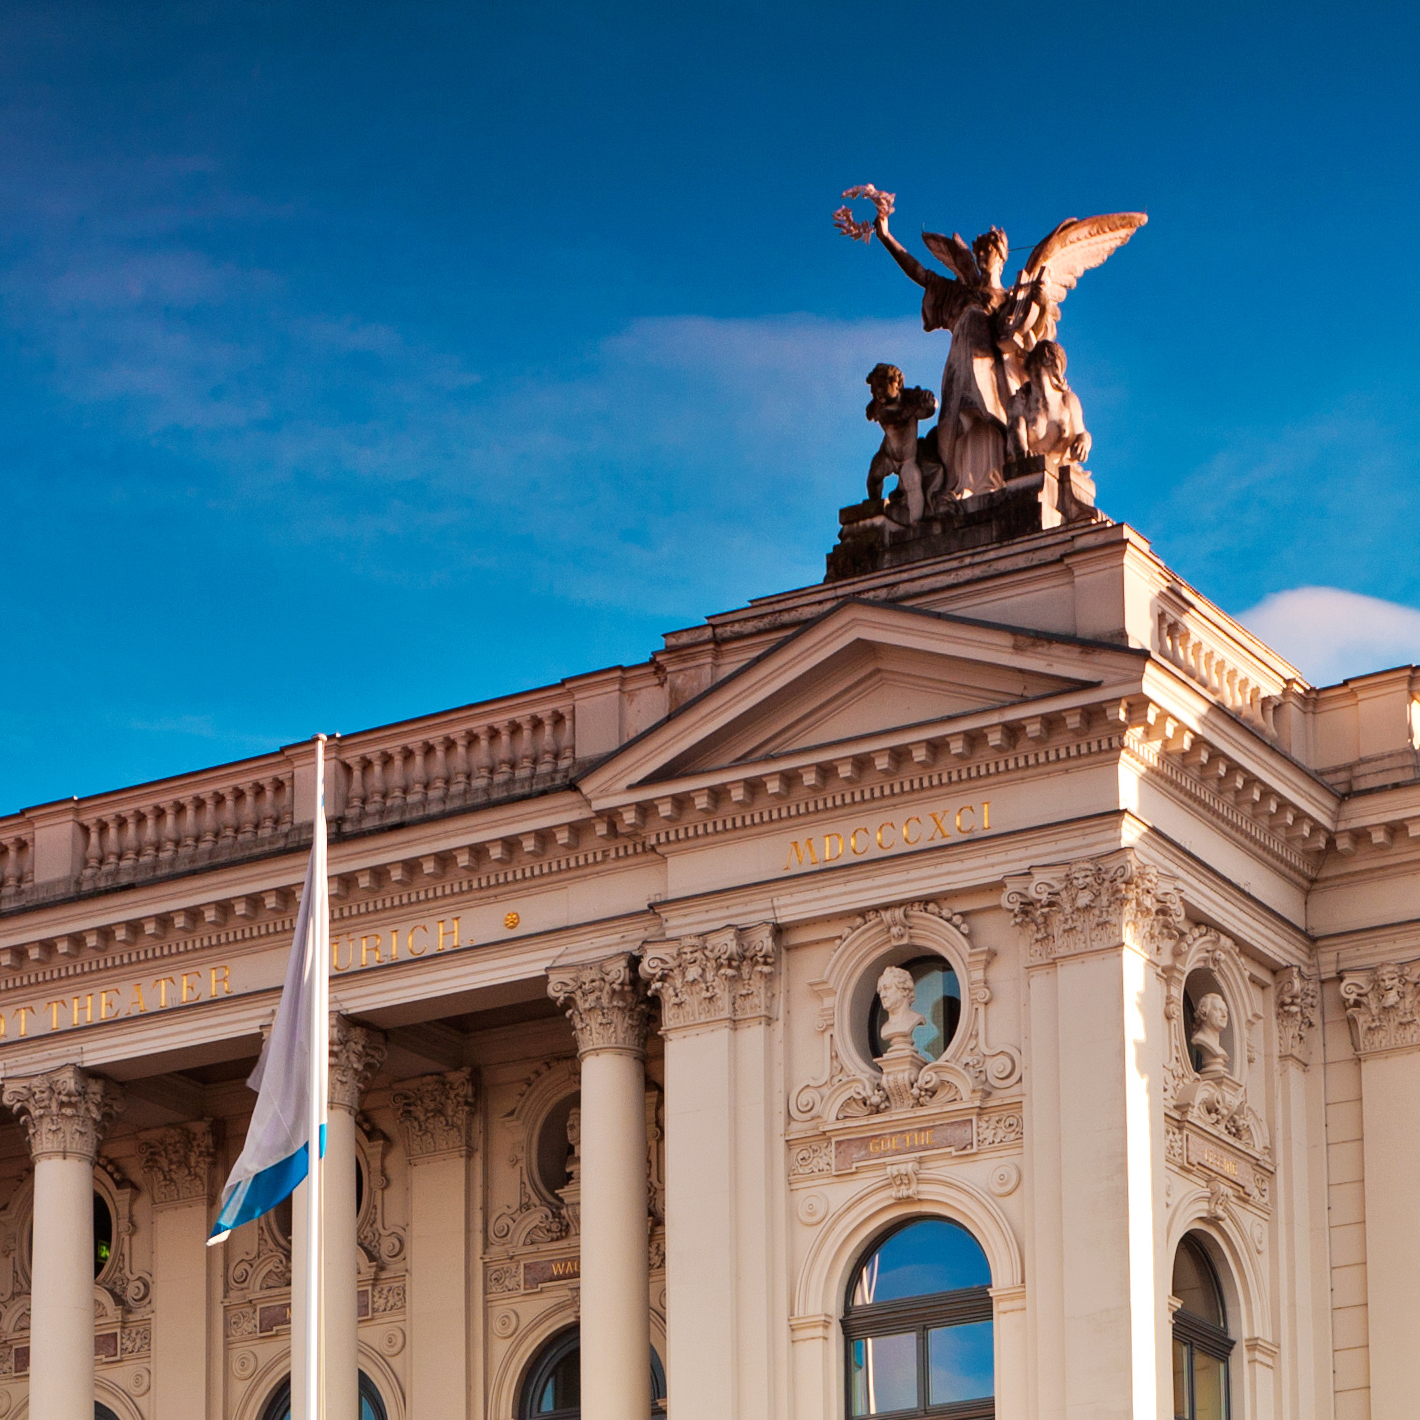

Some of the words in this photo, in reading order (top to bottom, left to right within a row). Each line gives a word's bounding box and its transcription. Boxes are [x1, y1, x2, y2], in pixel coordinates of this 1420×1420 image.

[782, 801, 993, 871] MDCCCXCI
[330, 915, 475, 972] ÜRICH.
[869, 1129, 935, 1154] GOETHE
